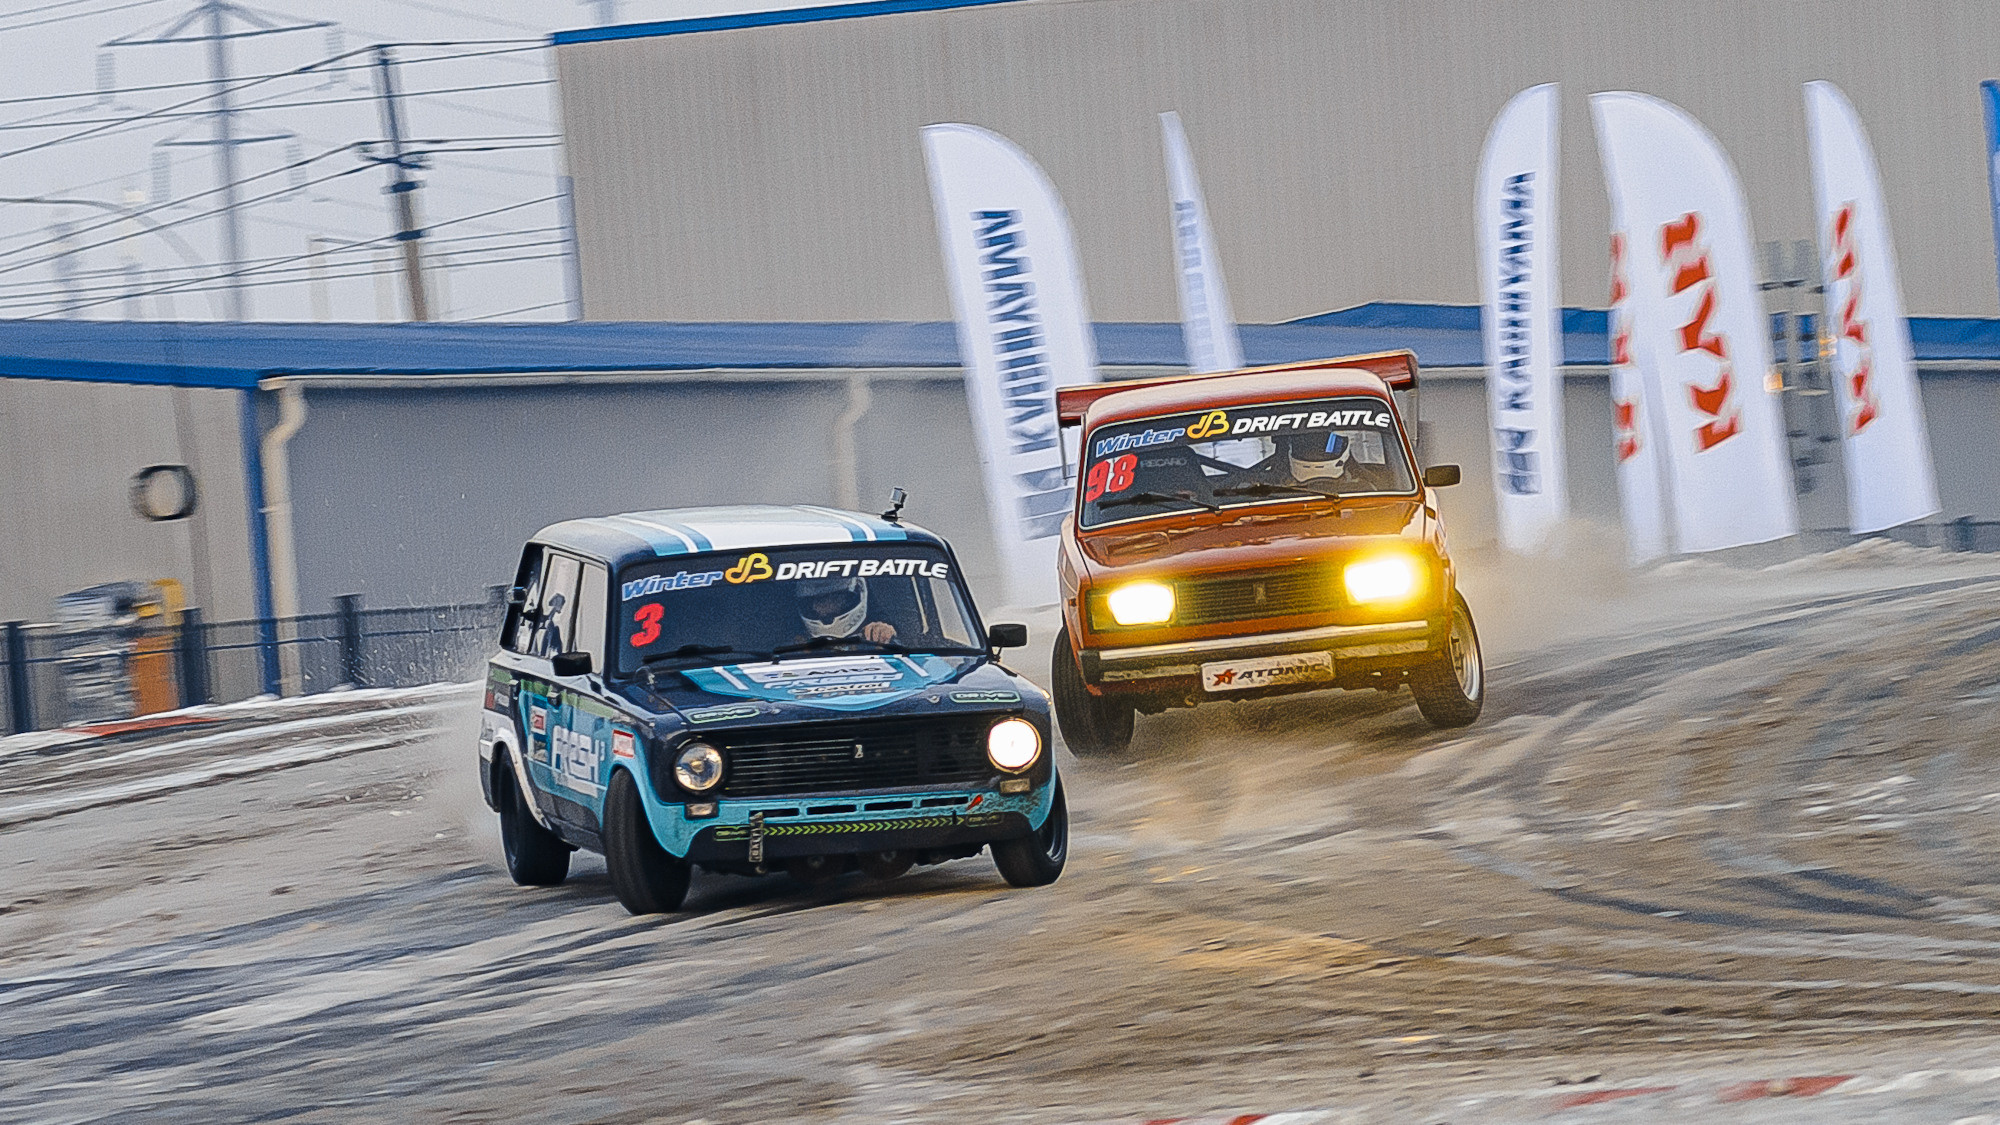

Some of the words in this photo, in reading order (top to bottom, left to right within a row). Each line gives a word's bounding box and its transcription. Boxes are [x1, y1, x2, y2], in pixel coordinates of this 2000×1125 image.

[1500, 172, 1536, 410] KAIYAMA
[1096, 428, 1185, 458] Winter
[1231, 413, 1308, 434] DRIFT
[1307, 410, 1391, 428] BATTLE
[1085, 453, 1138, 502] 98
[622, 571, 724, 601] Winter
[775, 559, 858, 581] DRIFT
[858, 559, 949, 579] BATTLE
[630, 603, 665, 647] 3
